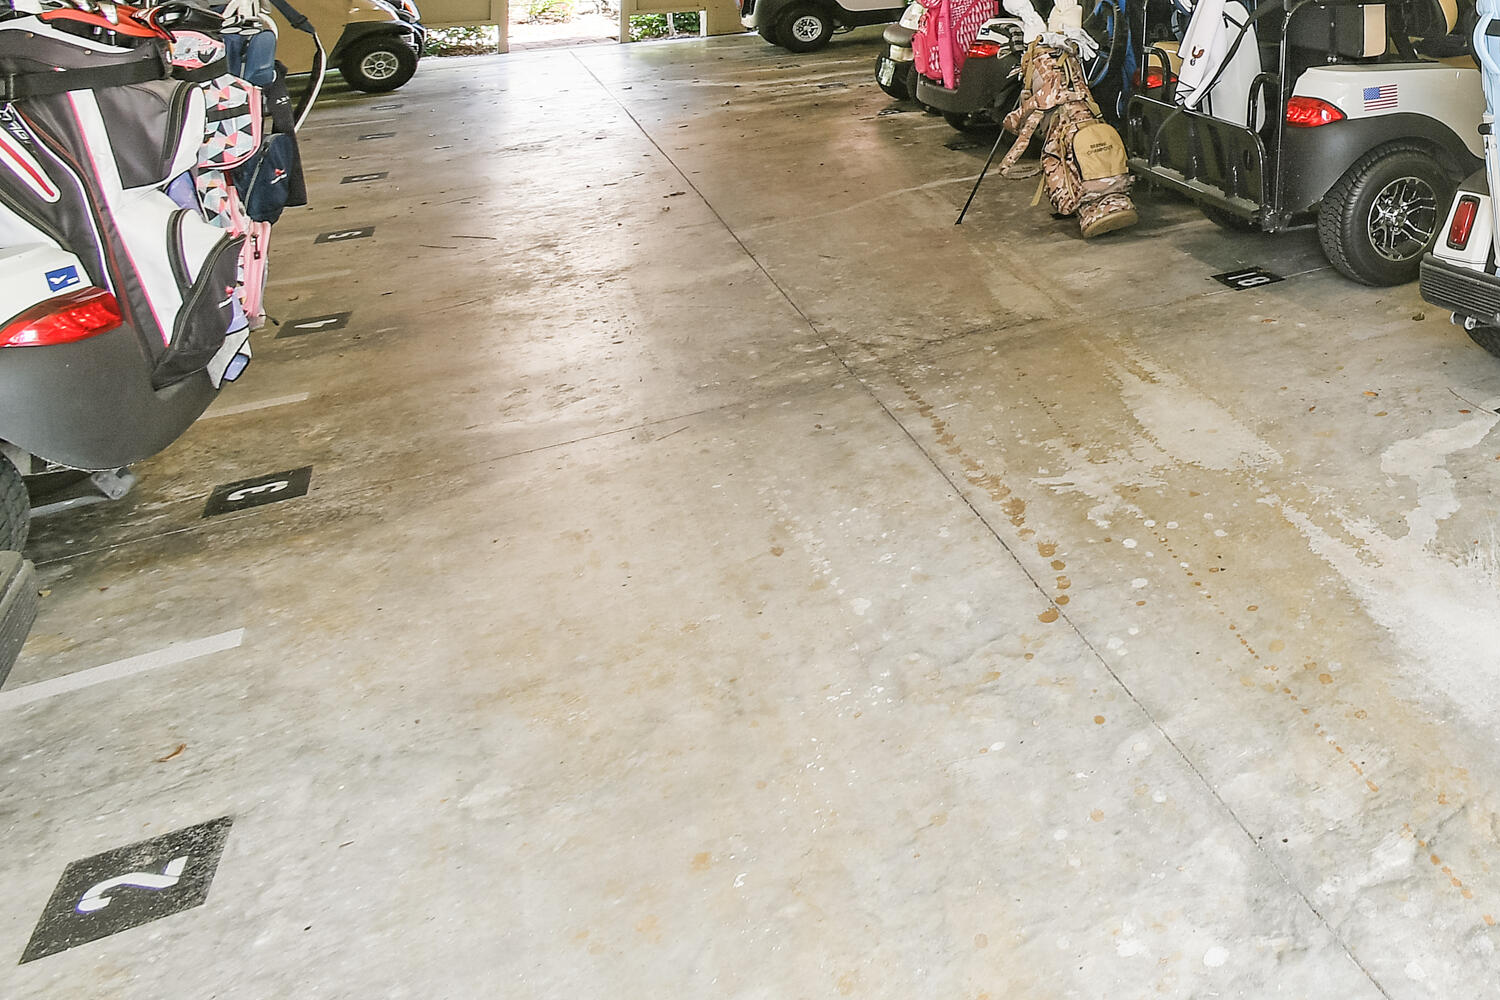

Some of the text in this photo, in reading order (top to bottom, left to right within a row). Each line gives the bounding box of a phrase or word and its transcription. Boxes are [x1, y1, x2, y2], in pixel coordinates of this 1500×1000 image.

[1227, 272, 1271, 286] 18
[226, 480, 289, 501] 3
[75, 855, 189, 914] 2
